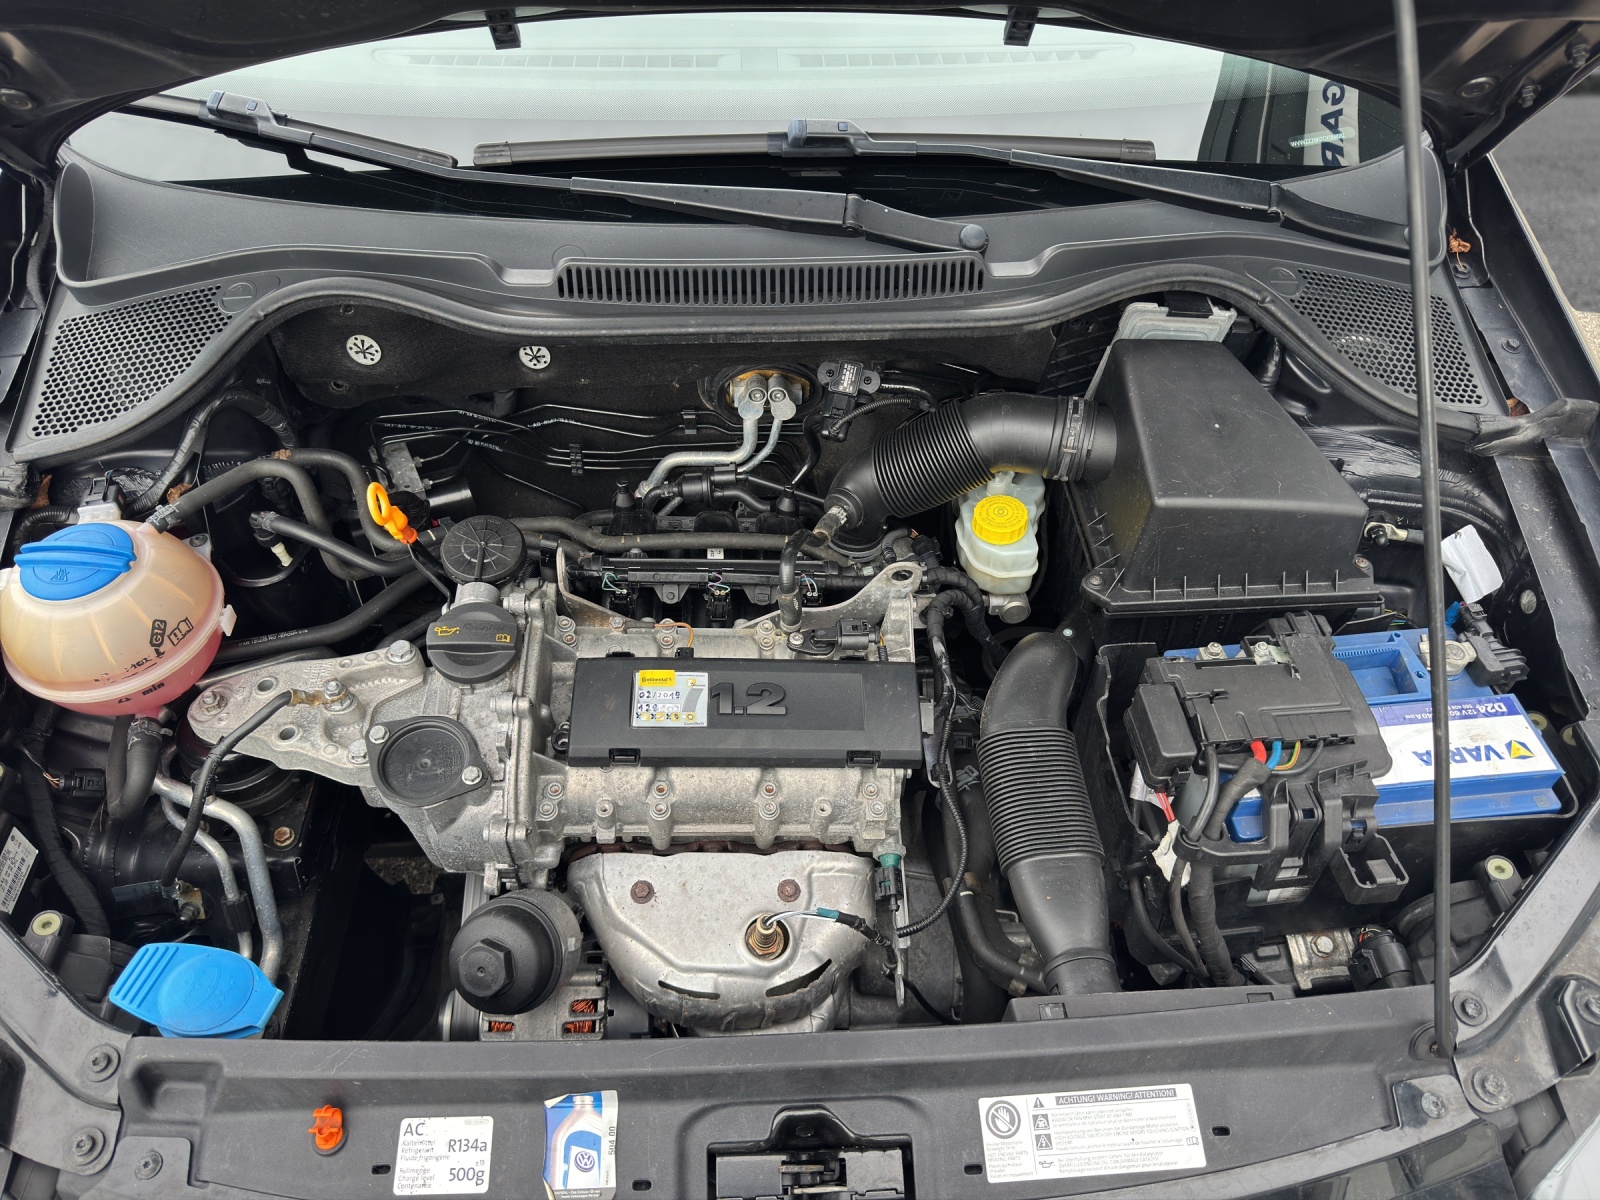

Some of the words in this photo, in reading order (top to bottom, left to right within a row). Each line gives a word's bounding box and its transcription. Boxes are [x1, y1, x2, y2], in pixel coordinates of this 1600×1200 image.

[153, 621, 165, 644] G12
[141, 682, 166, 696] min
[710, 682, 787, 715] 1.2
[1478, 702, 1507, 713] D24
[1412, 744, 1505, 767] VARA
[1058, 1095, 1096, 1105] ACHTUNG!
[1097, 1092, 1134, 1102] WARNING!
[1134, 1088, 1175, 1099] ATTENTION!
[403, 1123, 425, 1136] AC
[448, 1138, 488, 1152] R134a
[449, 1167, 485, 1187] 500g
